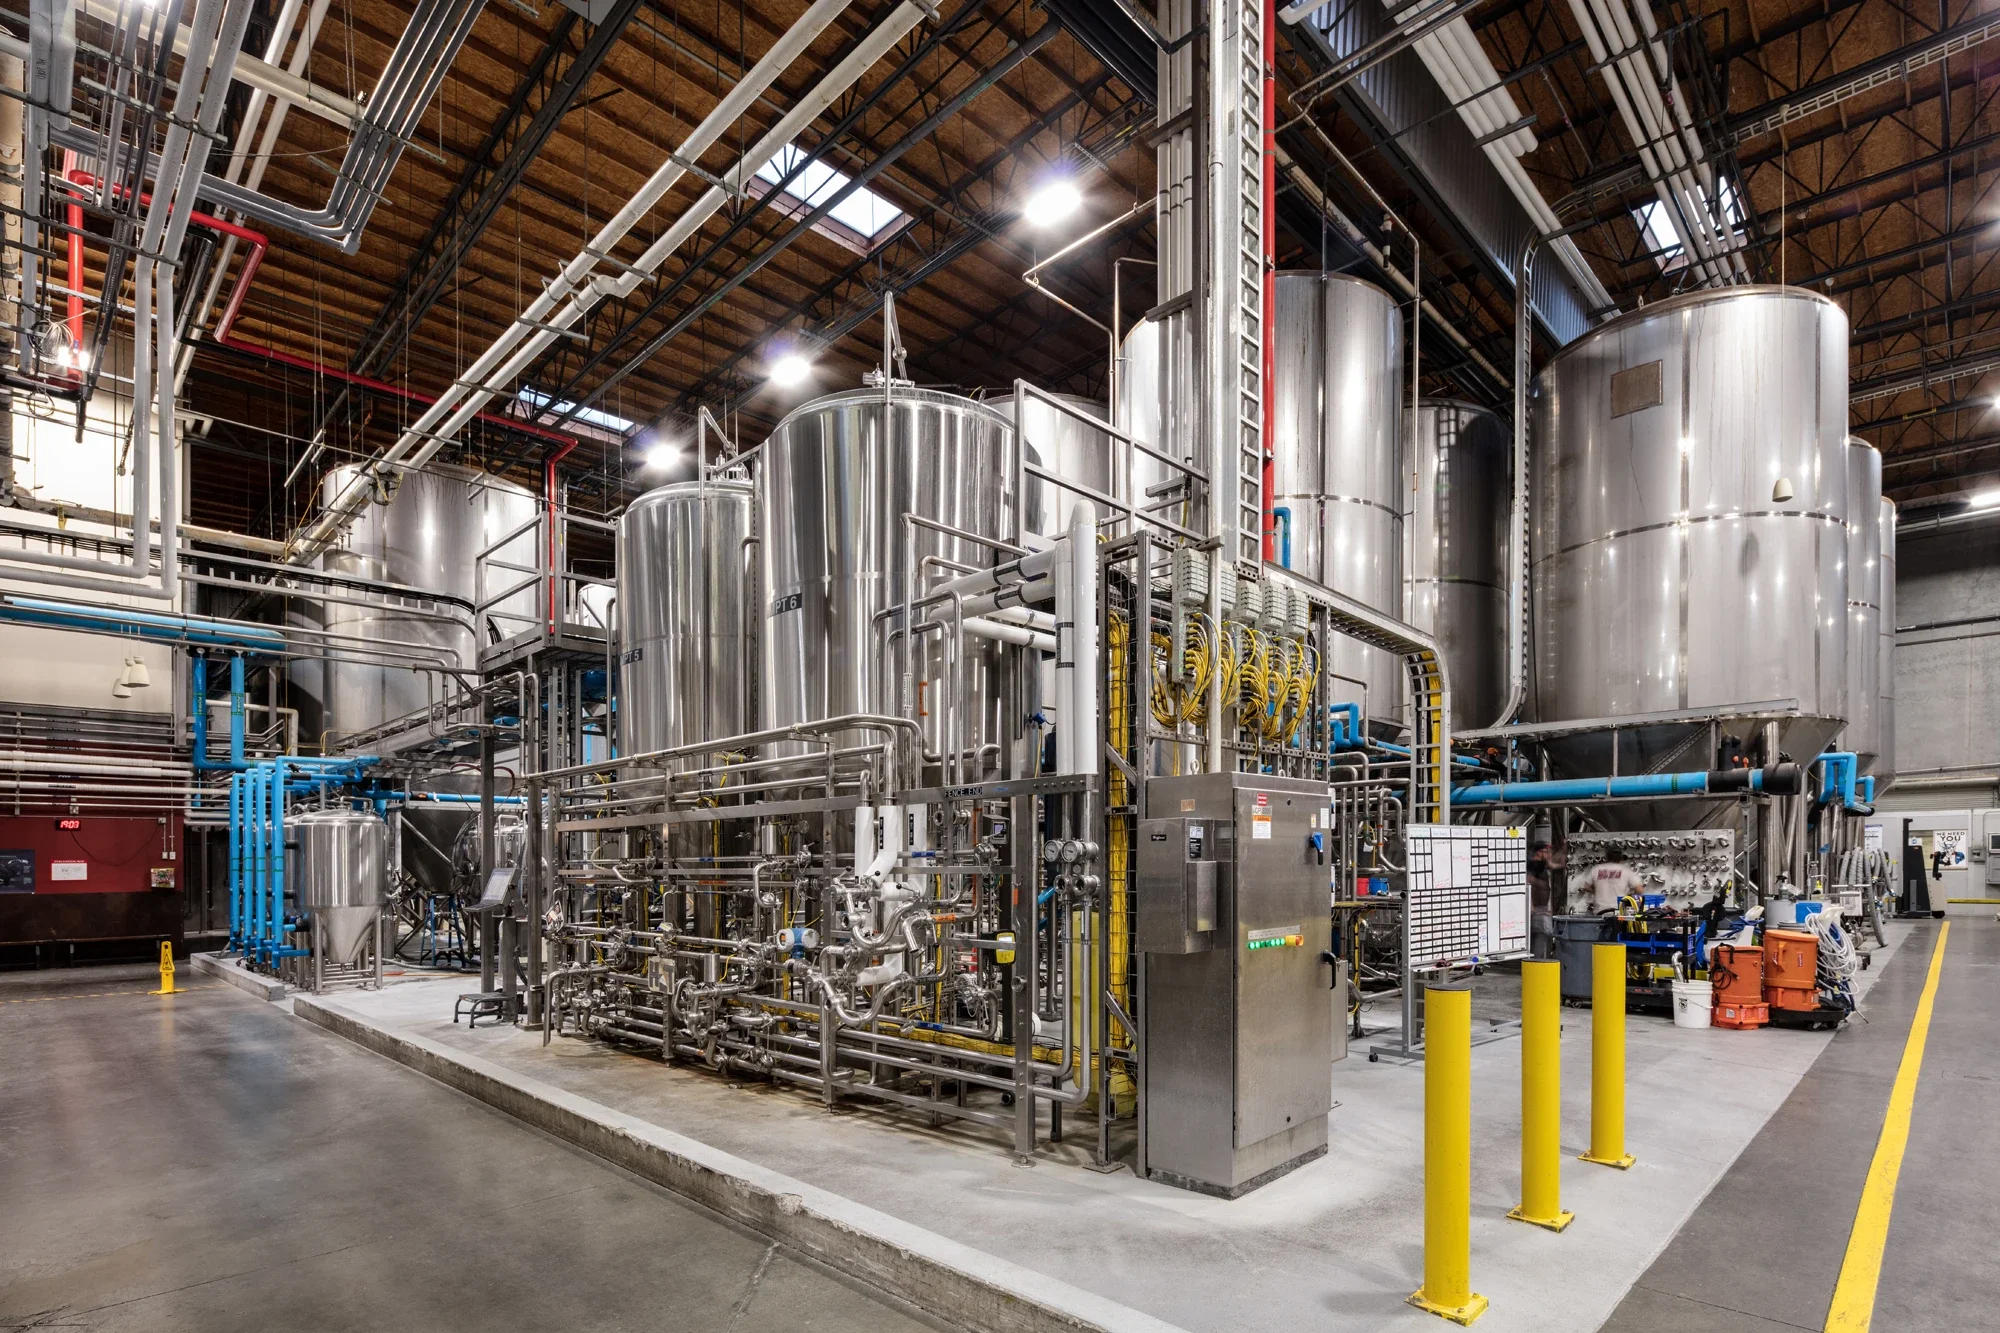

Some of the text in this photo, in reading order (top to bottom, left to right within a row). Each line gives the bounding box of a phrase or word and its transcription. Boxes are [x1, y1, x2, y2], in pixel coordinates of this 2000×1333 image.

[789, 595, 797, 610] 6
[634, 649, 640, 661] 5
[945, 786, 983, 797] FENCE END
[60, 820, 80, 829] 19:03
